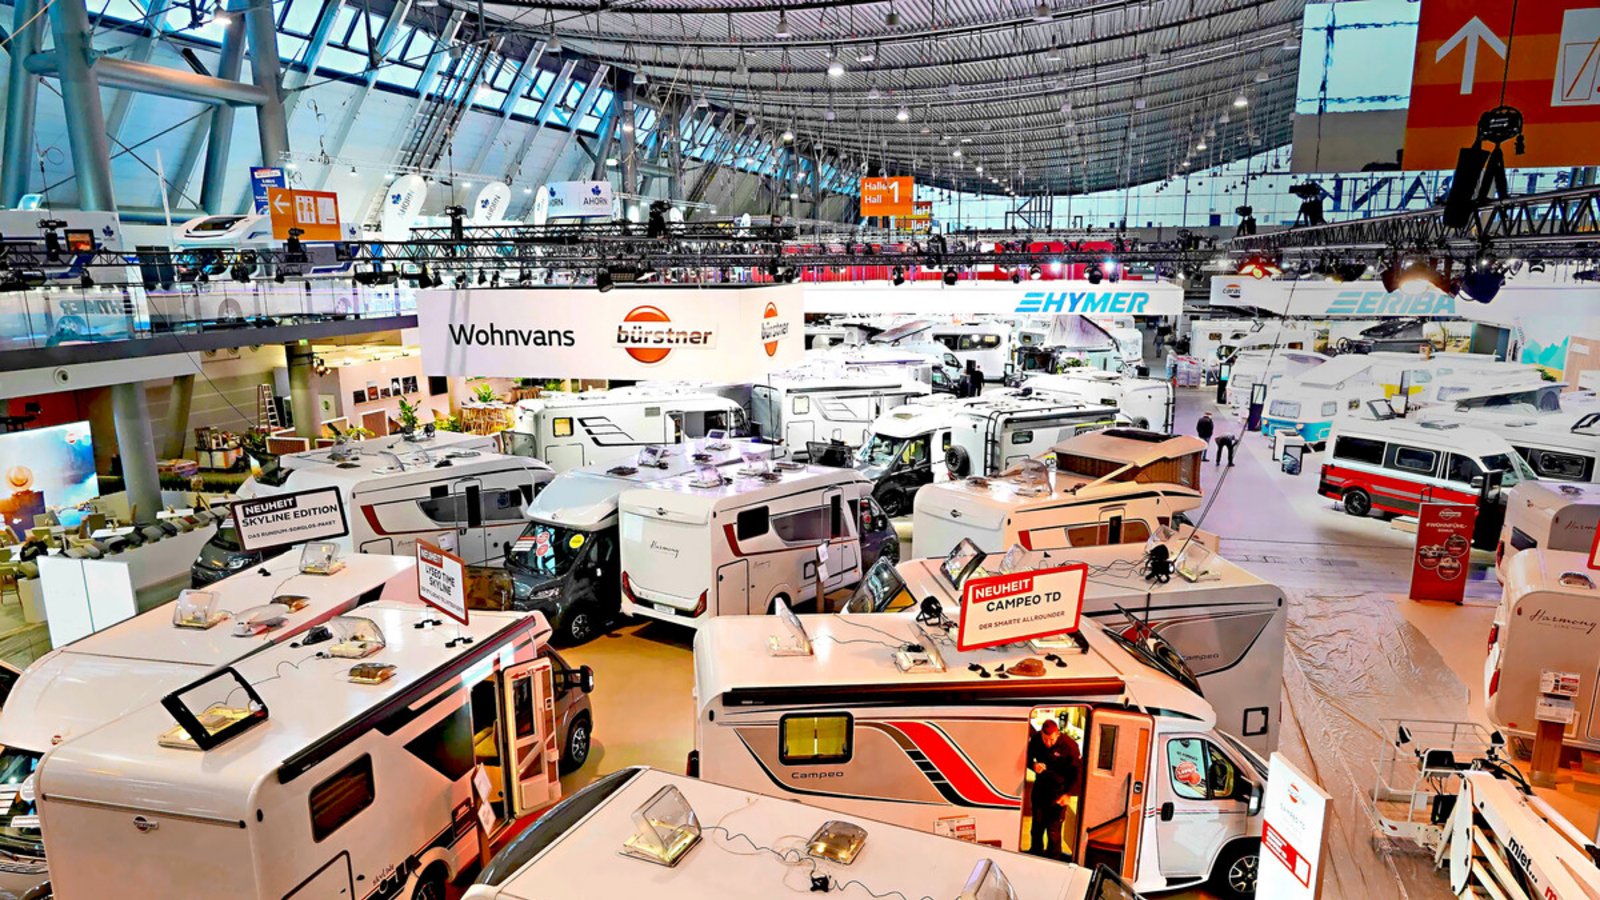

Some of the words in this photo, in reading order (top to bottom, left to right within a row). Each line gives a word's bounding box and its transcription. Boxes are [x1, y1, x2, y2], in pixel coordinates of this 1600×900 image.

[583, 197, 608, 206] AHORN
[864, 194, 882, 204] Hall
[889, 181, 899, 203] 1
[485, 193, 502, 221] AHORN
[1040, 291, 1150, 313] HYMER
[1355, 292, 1456, 315] ERIBA
[448, 322, 576, 347] Wohnvans
[616, 325, 713, 345] bürstner
[242, 511, 291, 528] SKYLINE
[293, 503, 338, 519] EDITION
[245, 497, 294, 516] NEUHEIT
[975, 578, 1031, 600] NEUHEIT
[986, 594, 1042, 612] CAMPEO
[1044, 591, 1061, 603] TD
[978, 622, 993, 630] DER
[993, 617, 1021, 628] SMARTE
[1022, 610, 1065, 624] ALLROUNDER
[1528, 608, 1597, 635] Harmony
[791, 770, 844, 780] Campeo
